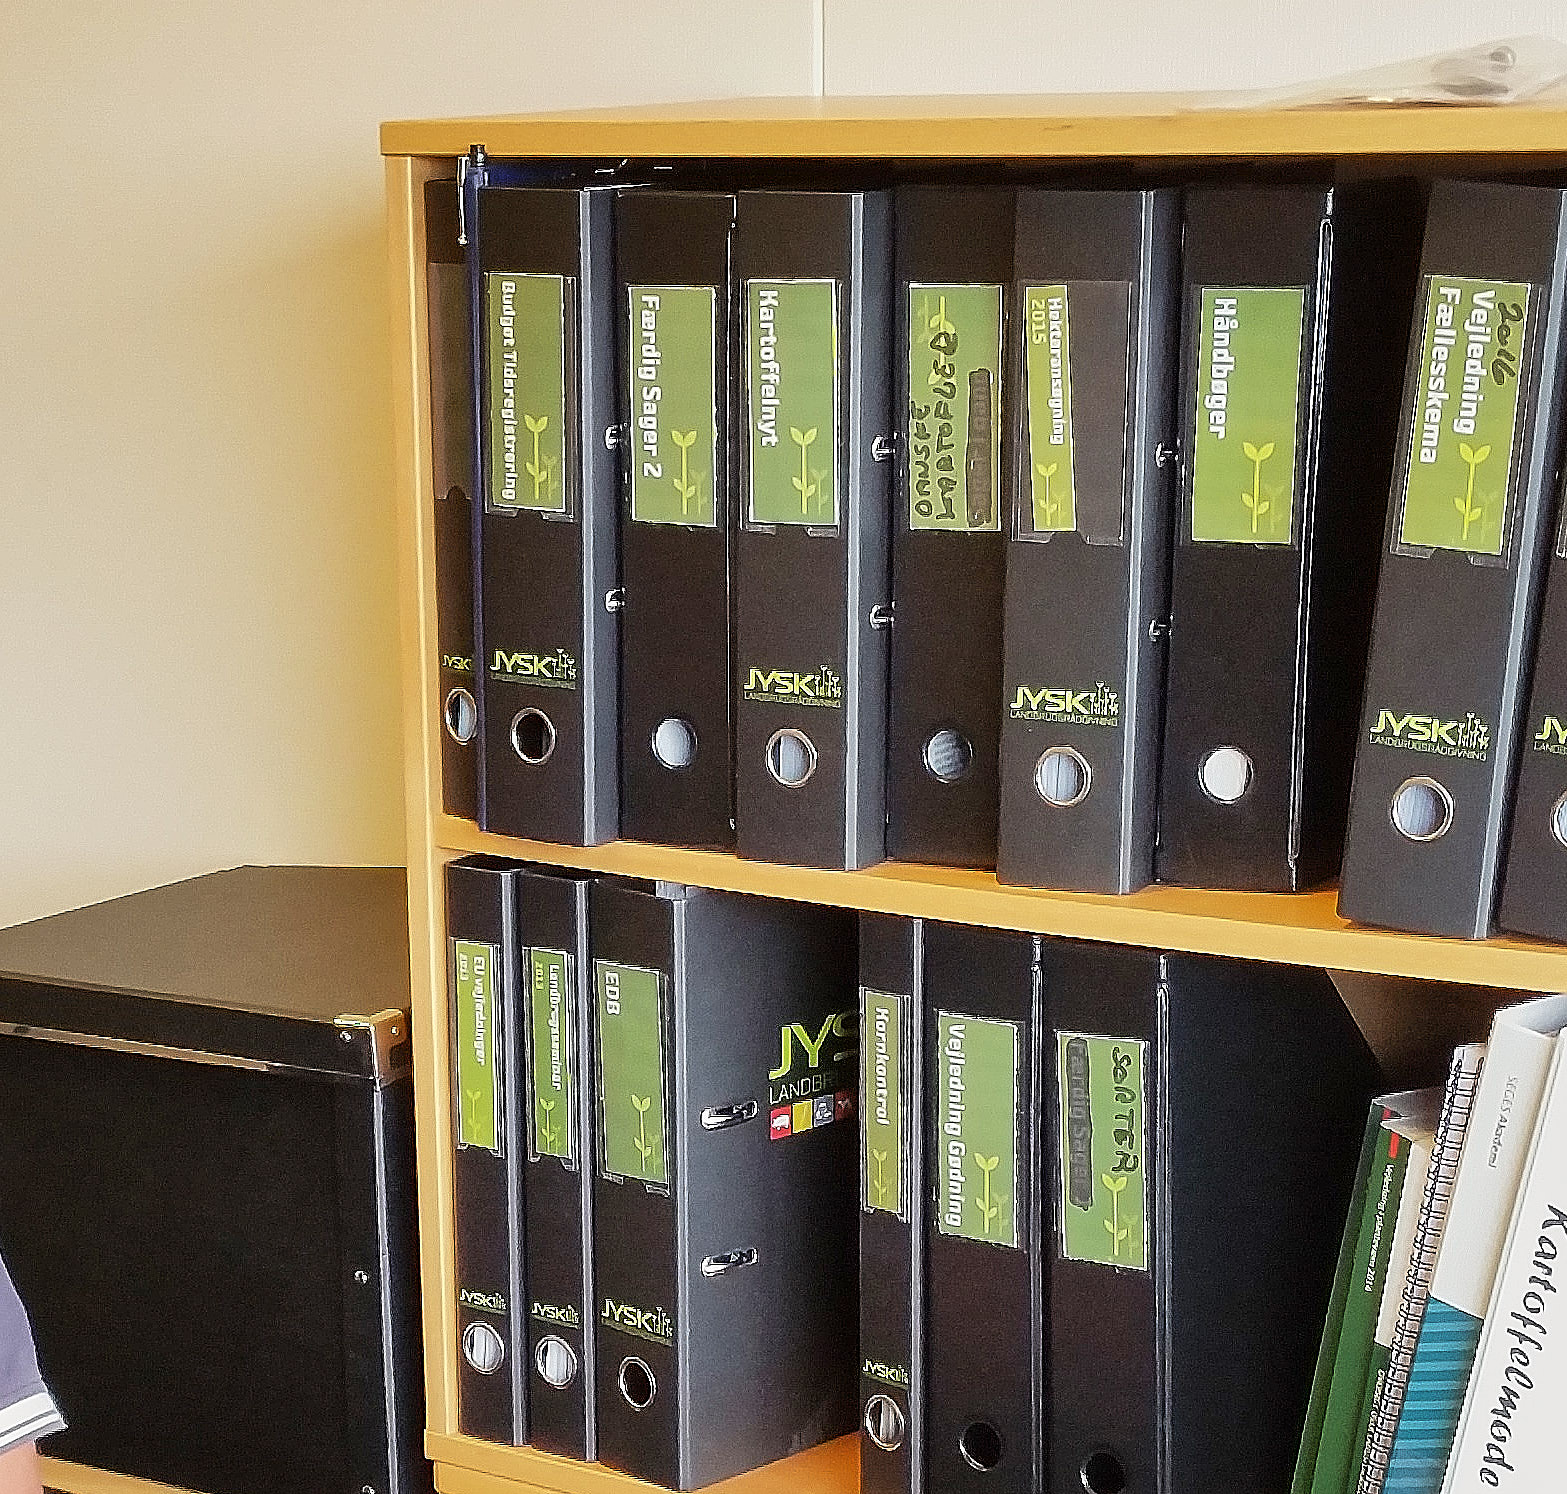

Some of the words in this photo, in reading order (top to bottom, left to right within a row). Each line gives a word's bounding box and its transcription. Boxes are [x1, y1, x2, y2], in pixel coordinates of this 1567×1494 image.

[500, 281, 516, 347] Budget
[1031, 299, 1046, 345] 2015
[636, 295, 660, 380] Færdig
[1491, 302, 1523, 386] 2016
[756, 290, 780, 447] Kartoffelnyt
[1204, 298, 1238, 440] Håndbøger
[1419, 286, 1461, 464] Fællesskema
[1453, 290, 1495, 434] Vejledning
[638, 386, 661, 447] Sager
[642, 462, 662, 479] 2
[490, 650, 553, 677] JYSK
[744, 668, 815, 696] JYSK
[1010, 686, 1090, 714] JYSK
[1370, 709, 1458, 745] JYSK
[473, 956, 485, 975] EU
[605, 970, 621, 1015] EDB
[874, 1007, 890, 1126] Kornkontrol
[943, 1024, 966, 1136] Vejledning
[943, 1140, 967, 1228] Gødning
[460, 1289, 493, 1308] JYSK
[532, 1302, 565, 1322] JYSK
[601, 1298, 656, 1332] JYSK
[863, 1359, 896, 1380] JYSK
